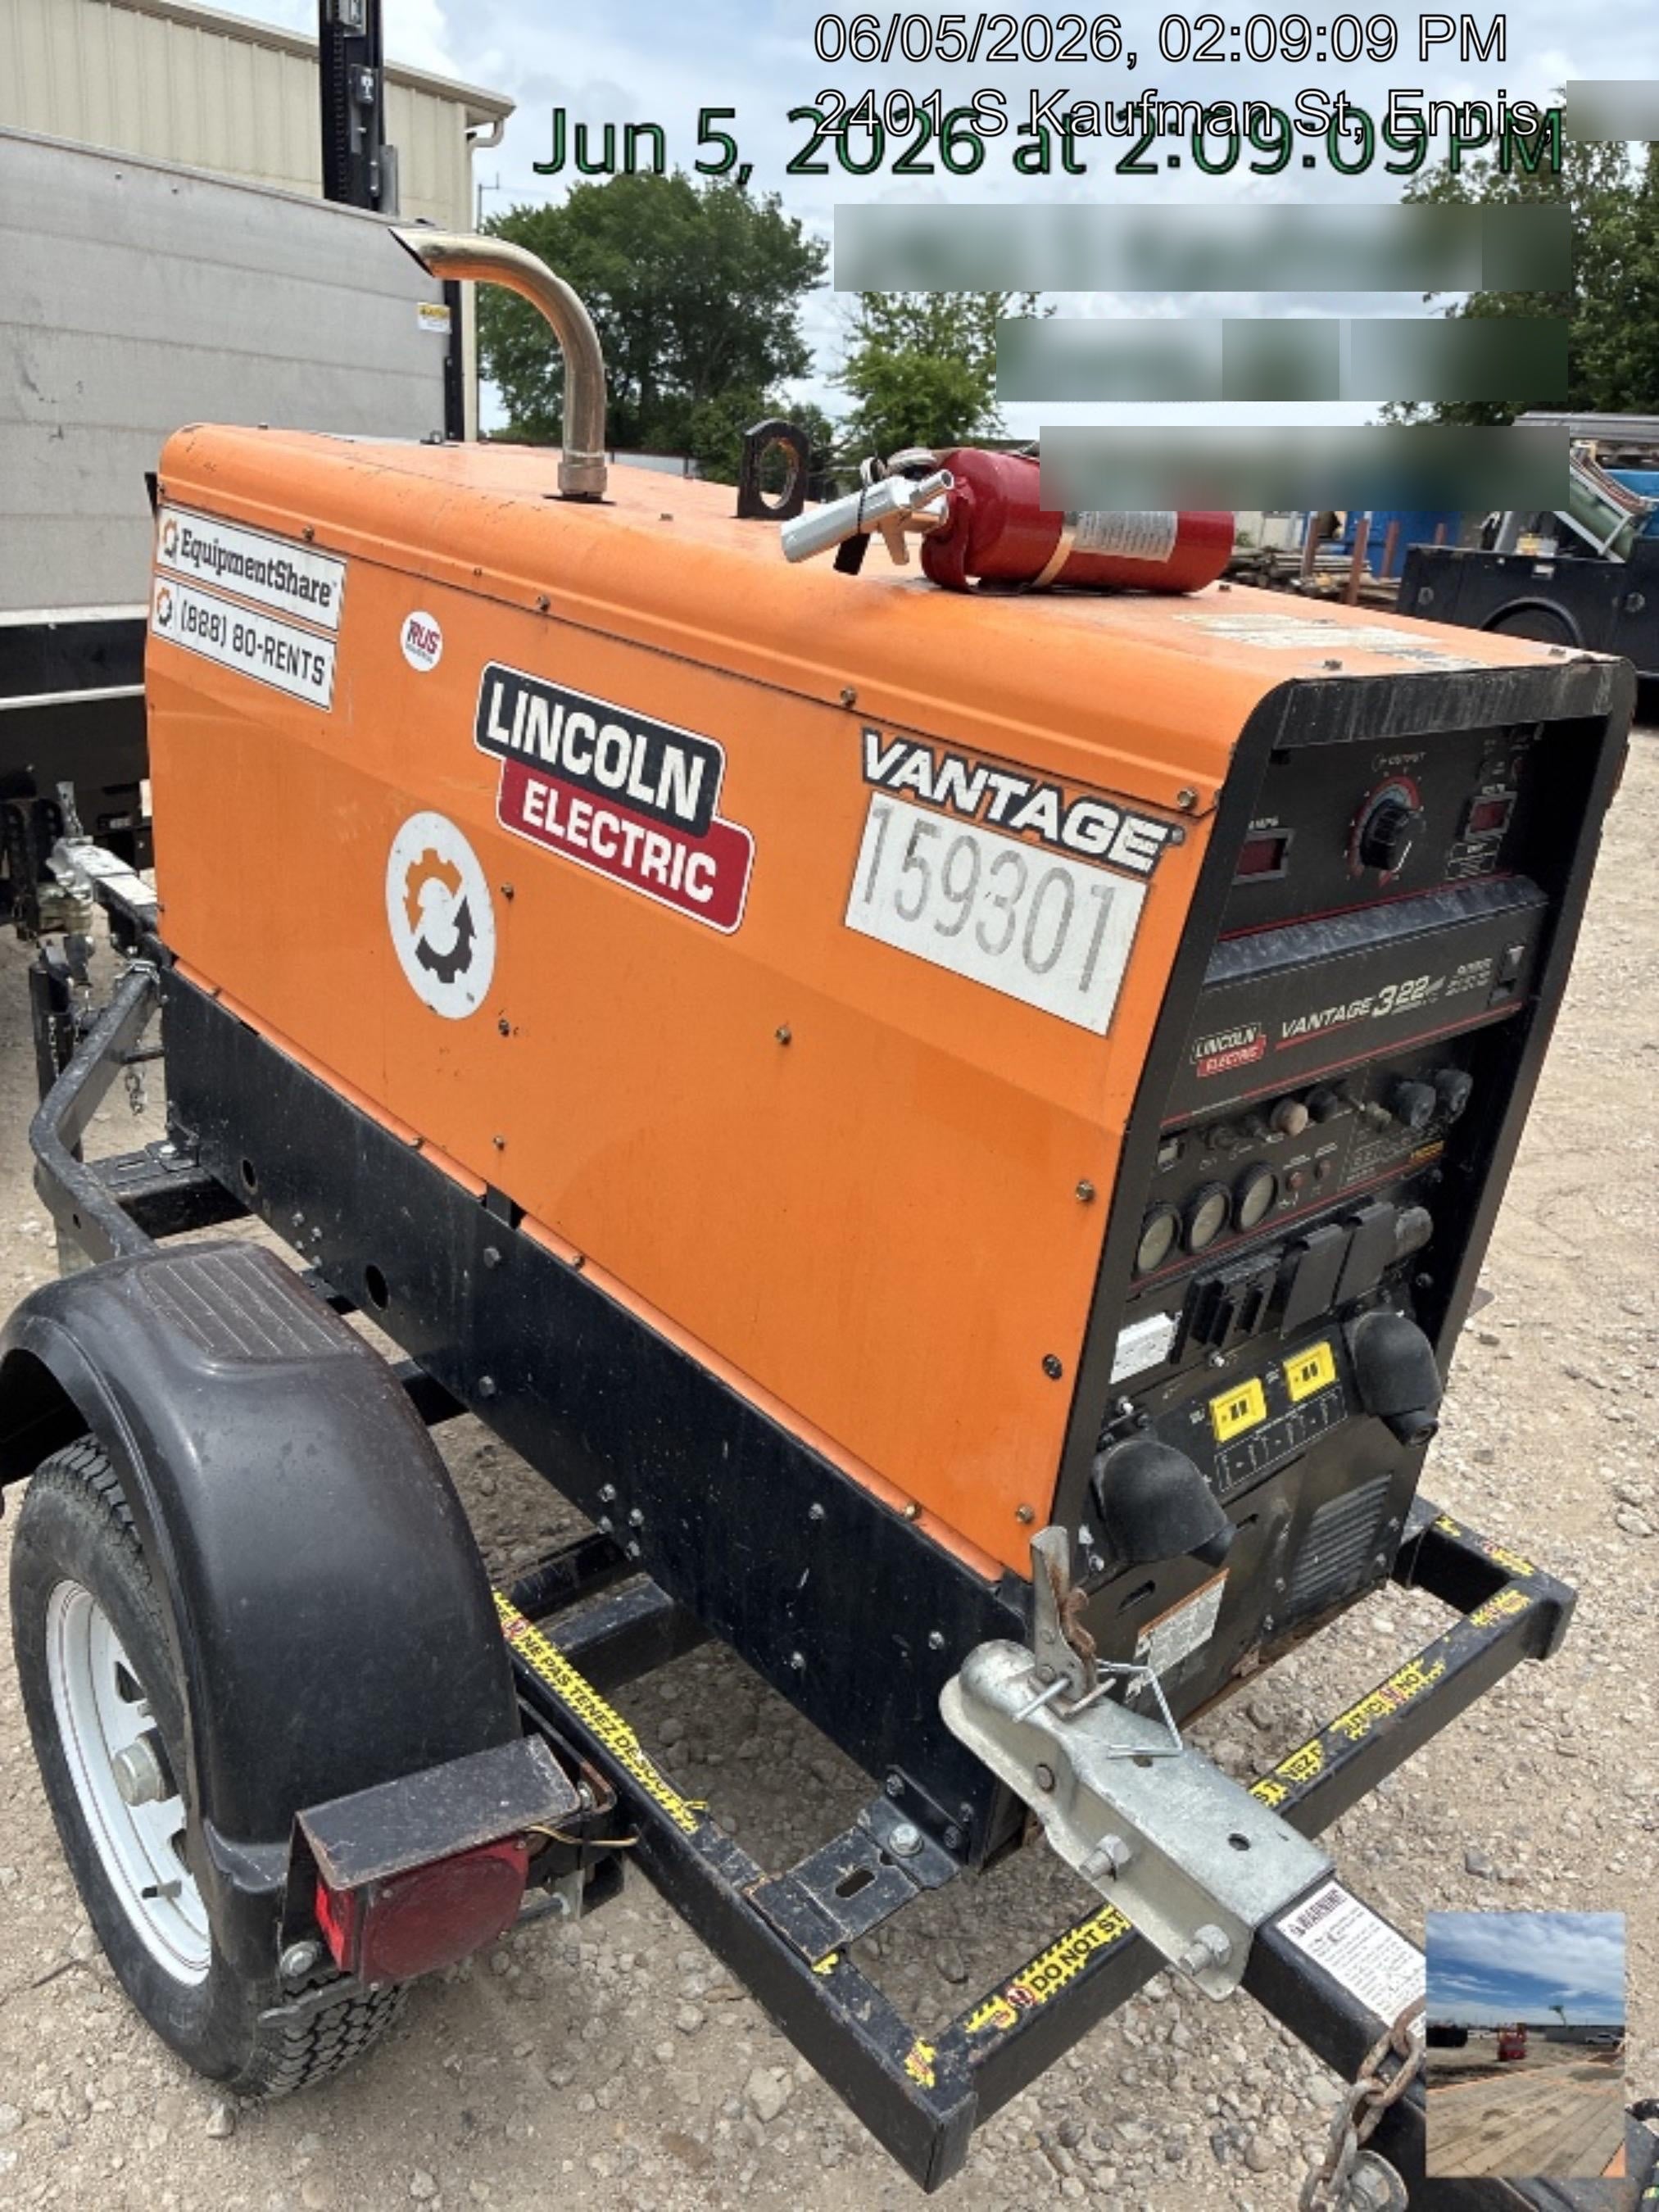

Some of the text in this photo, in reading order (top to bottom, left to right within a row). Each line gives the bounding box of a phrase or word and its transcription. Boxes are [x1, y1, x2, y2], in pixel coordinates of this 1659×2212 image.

[180, 528, 333, 608] EquipmentShare
[180, 599, 325, 687] (888) 80-RENTS
[486, 682, 705, 823] LINCOLN
[522, 777, 717, 904] ELECTRIC
[862, 728, 1170, 877] VANTAGE
[863, 804, 1116, 994] 159301
[1194, 1027, 1258, 1058] LINCOLN
[1281, 996, 1376, 1038] VANTAGE
[540, 1655, 571, 1687] PAS
[1029, 1961, 1063, 1992] DO
[1058, 1928, 1100, 1967] NOT
